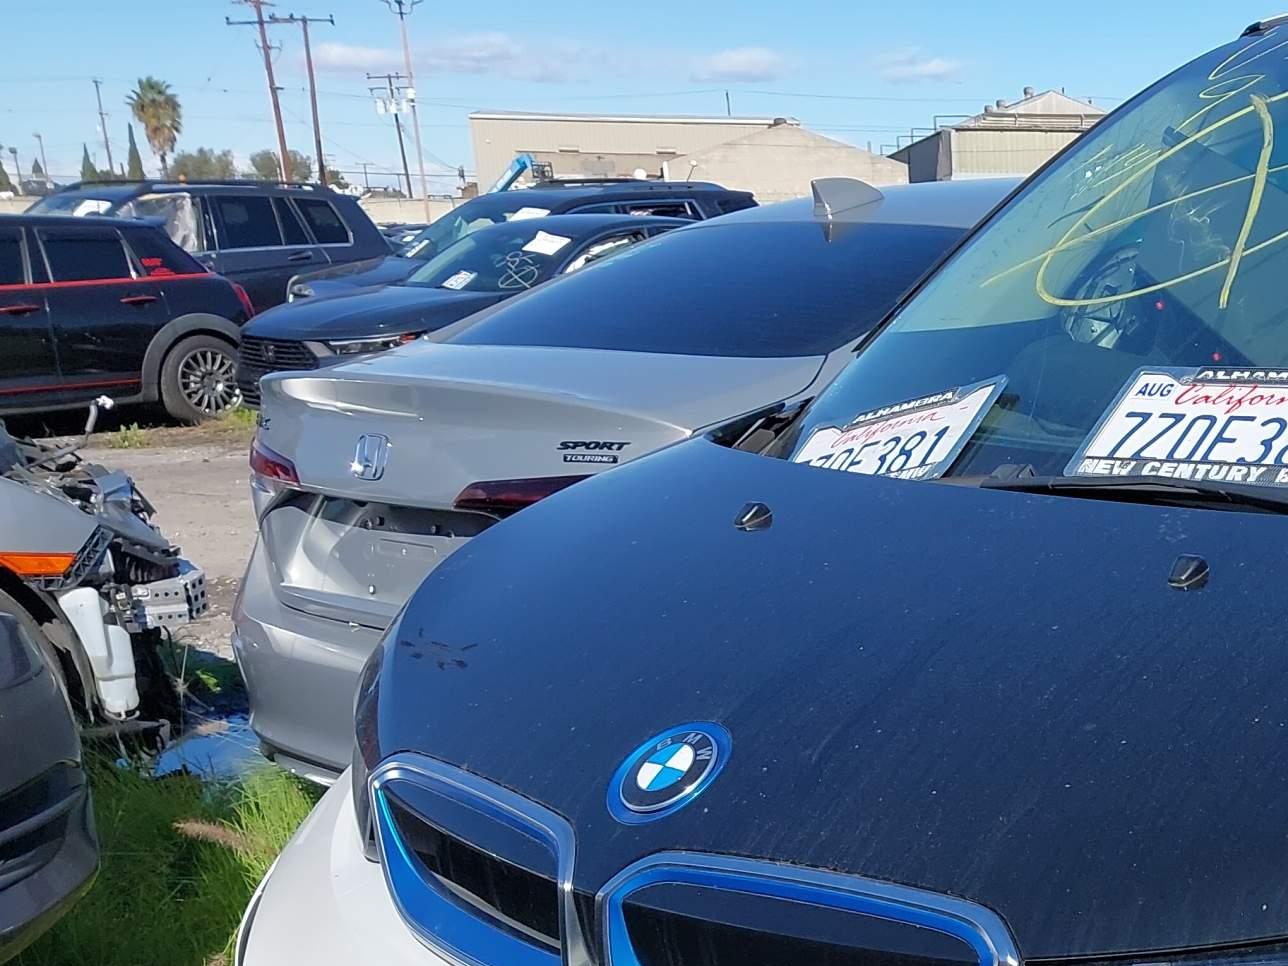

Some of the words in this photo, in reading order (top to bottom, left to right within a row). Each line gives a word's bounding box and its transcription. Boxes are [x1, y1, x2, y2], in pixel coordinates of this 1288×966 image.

[1136, 382, 1175, 398] AUG
[556, 440, 632, 451] SPORT
[1077, 458, 1137, 476] NEW
[1141, 461, 1268, 482] CENTURY
[656, 732, 713, 760] BMW
